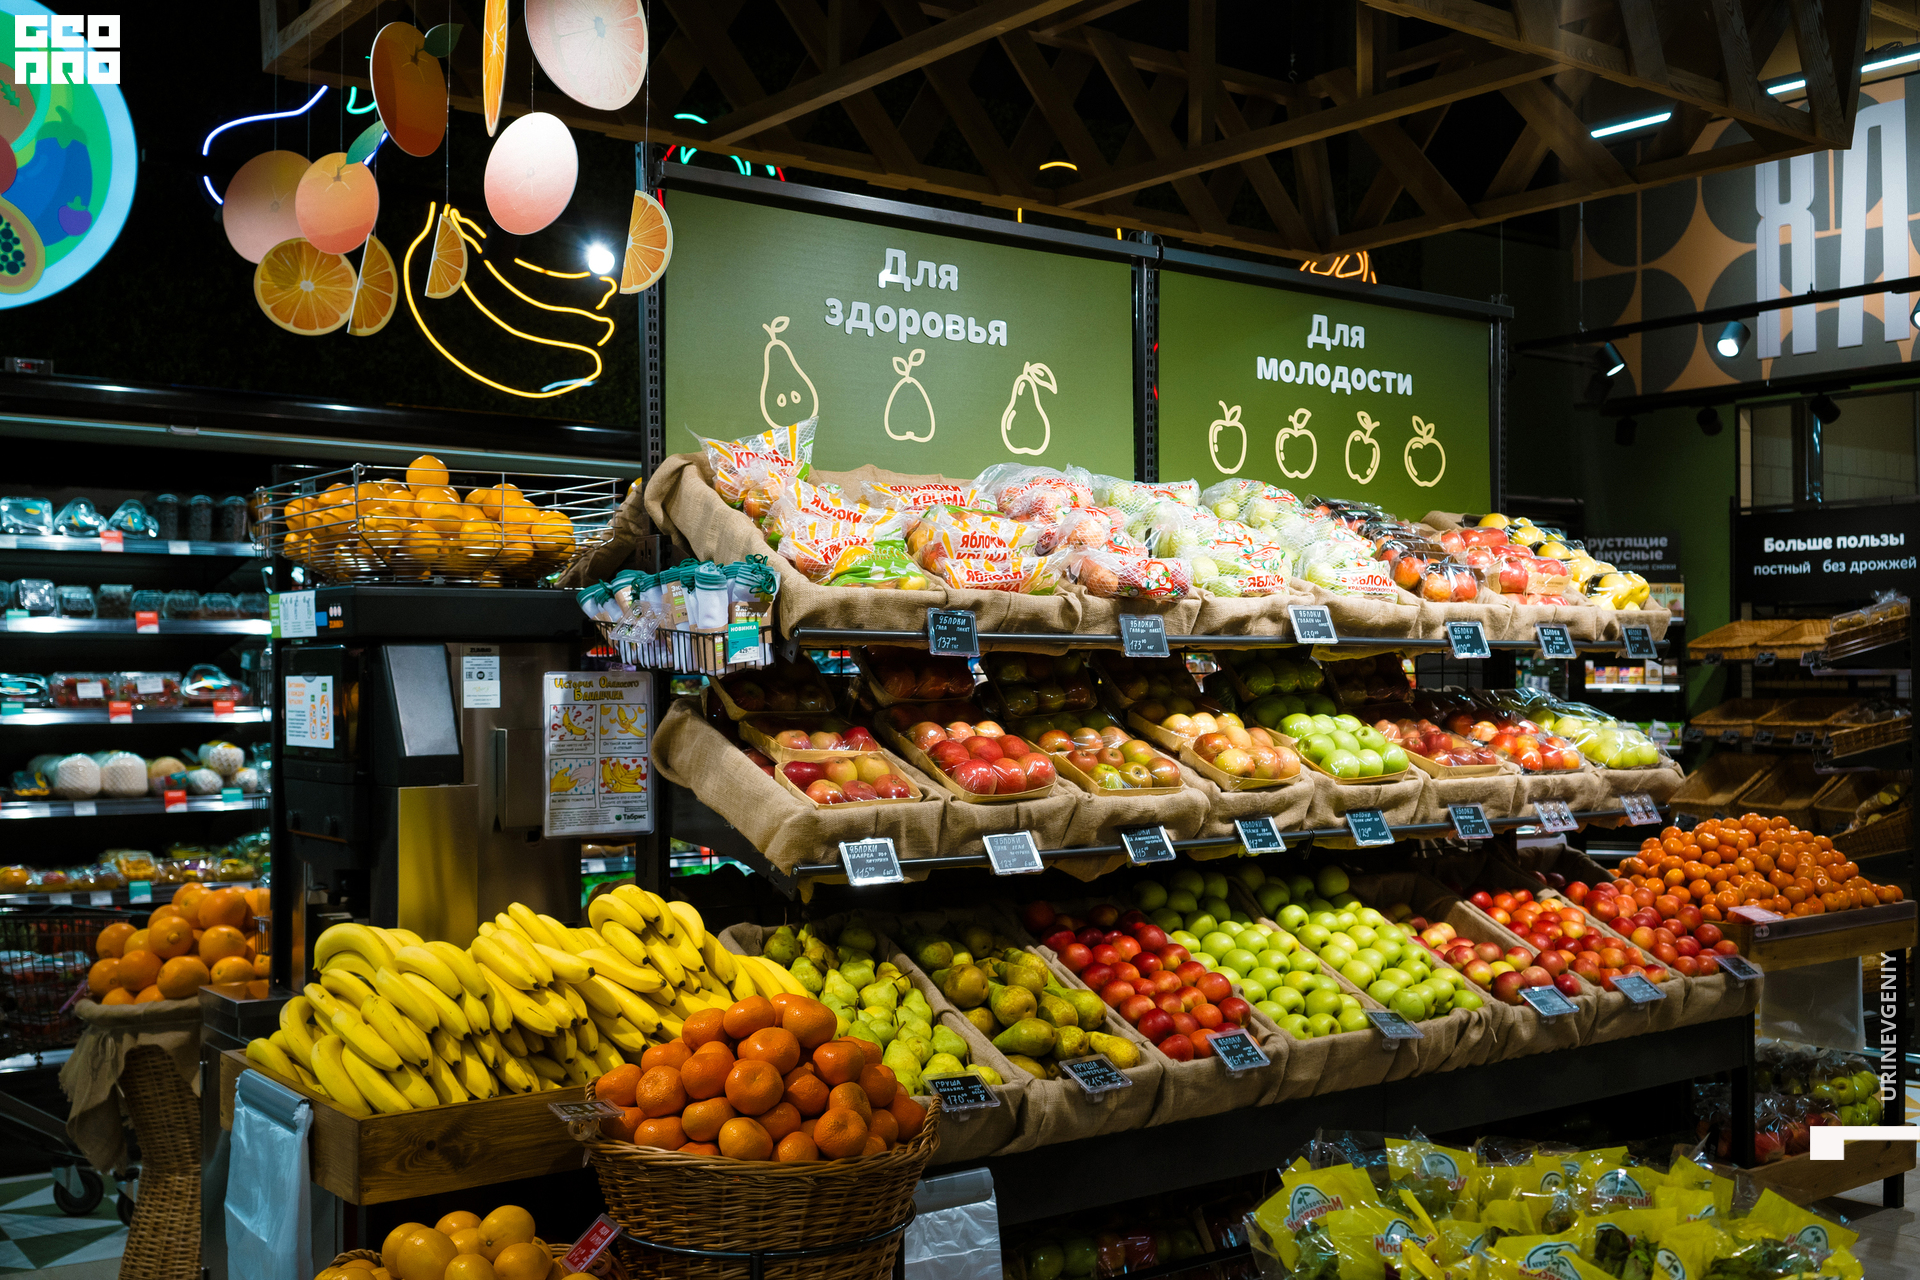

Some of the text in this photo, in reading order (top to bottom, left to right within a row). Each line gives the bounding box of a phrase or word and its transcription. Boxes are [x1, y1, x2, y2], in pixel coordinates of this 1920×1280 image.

[878, 247, 959, 292] Для
[824, 296, 1008, 348] здоровья
[1307, 312, 1365, 350] Для
[1256, 355, 1414, 396] молодости
[1585, 536, 1668, 550] рустящие
[1764, 533, 1905, 553] Больше пользы
[1617, 563, 1650, 571] лебные
[1753, 556, 1917, 575] постный без дрожжей
[939, 615, 966, 625] ЯБЛОКИ
[1130, 620, 1154, 628] ЯБЛОКИ
[730, 624, 757, 633] НОВИНКА
[554, 678, 594, 690] История
[573, 688, 624, 701] Бананчика
[623, 813, 647, 821] Табрис
[994, 837, 1020, 845] ЯБЛОКИ
[849, 845, 878, 854] ЯБЛОКИ
[1218, 1036, 1242, 1046] ЯБЛОКИ
[1073, 1061, 1099, 1072] ГРУША
[935, 1080, 961, 1088] ГРУША
